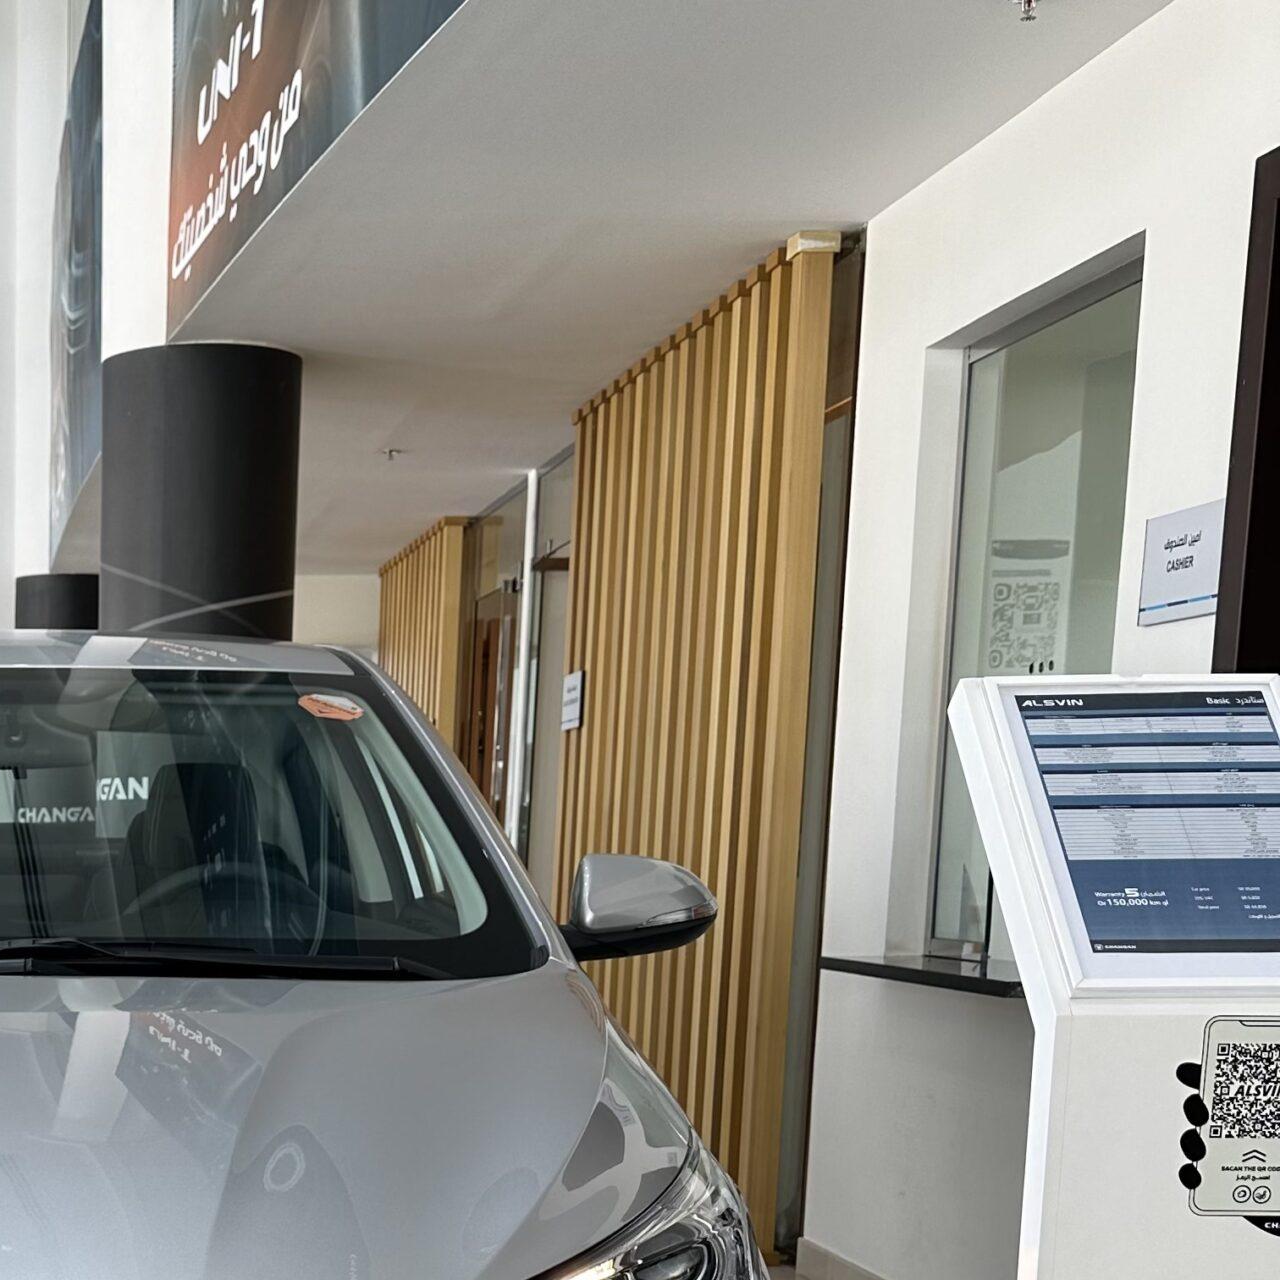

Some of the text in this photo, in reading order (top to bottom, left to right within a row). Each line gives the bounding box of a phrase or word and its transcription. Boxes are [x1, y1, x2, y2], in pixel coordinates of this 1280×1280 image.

[171, 68, 303, 281] من وحي شخصيتك
[1166, 555, 1194, 573] CASHIER
[1021, 698, 1084, 707] ALSVIN
[96, 776, 149, 801] GAN
[1124, 887, 1140, 898] 5
[1107, 898, 1148, 906] 150,000
